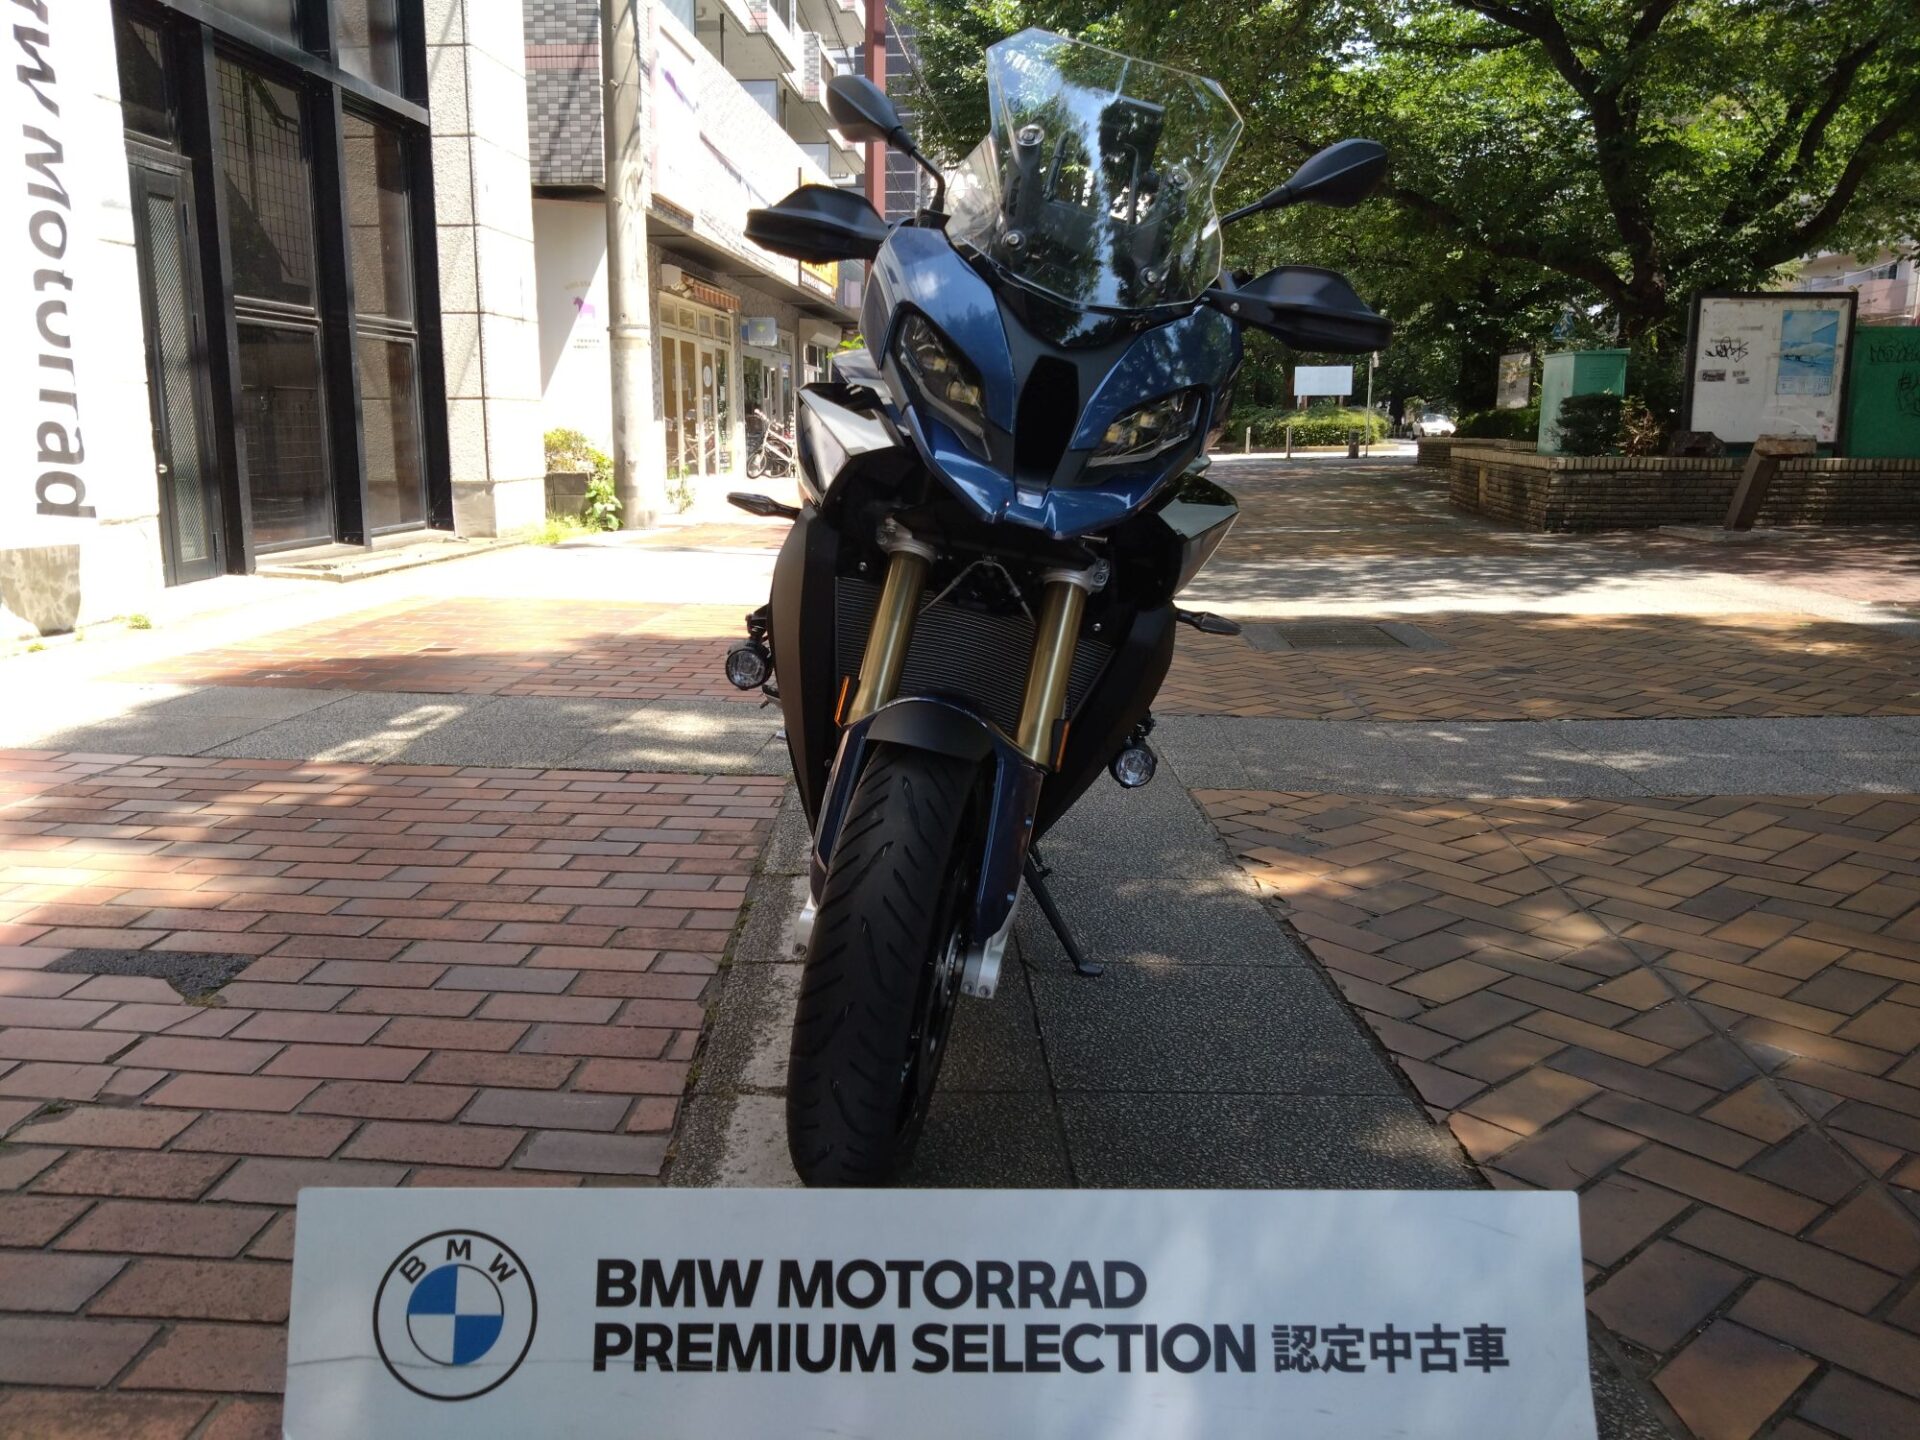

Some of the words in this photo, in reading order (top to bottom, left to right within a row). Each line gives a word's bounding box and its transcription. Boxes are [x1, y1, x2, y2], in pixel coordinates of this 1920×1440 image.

[399, 1239, 517, 1284] BMW
[595, 1258, 765, 1309] BMW
[777, 1258, 1148, 1310] MOTORRAD
[592, 1322, 898, 1374] PREMIUM
[911, 1322, 1257, 1375] SELECTION
[1272, 1323, 1511, 1374] 認定中古車
